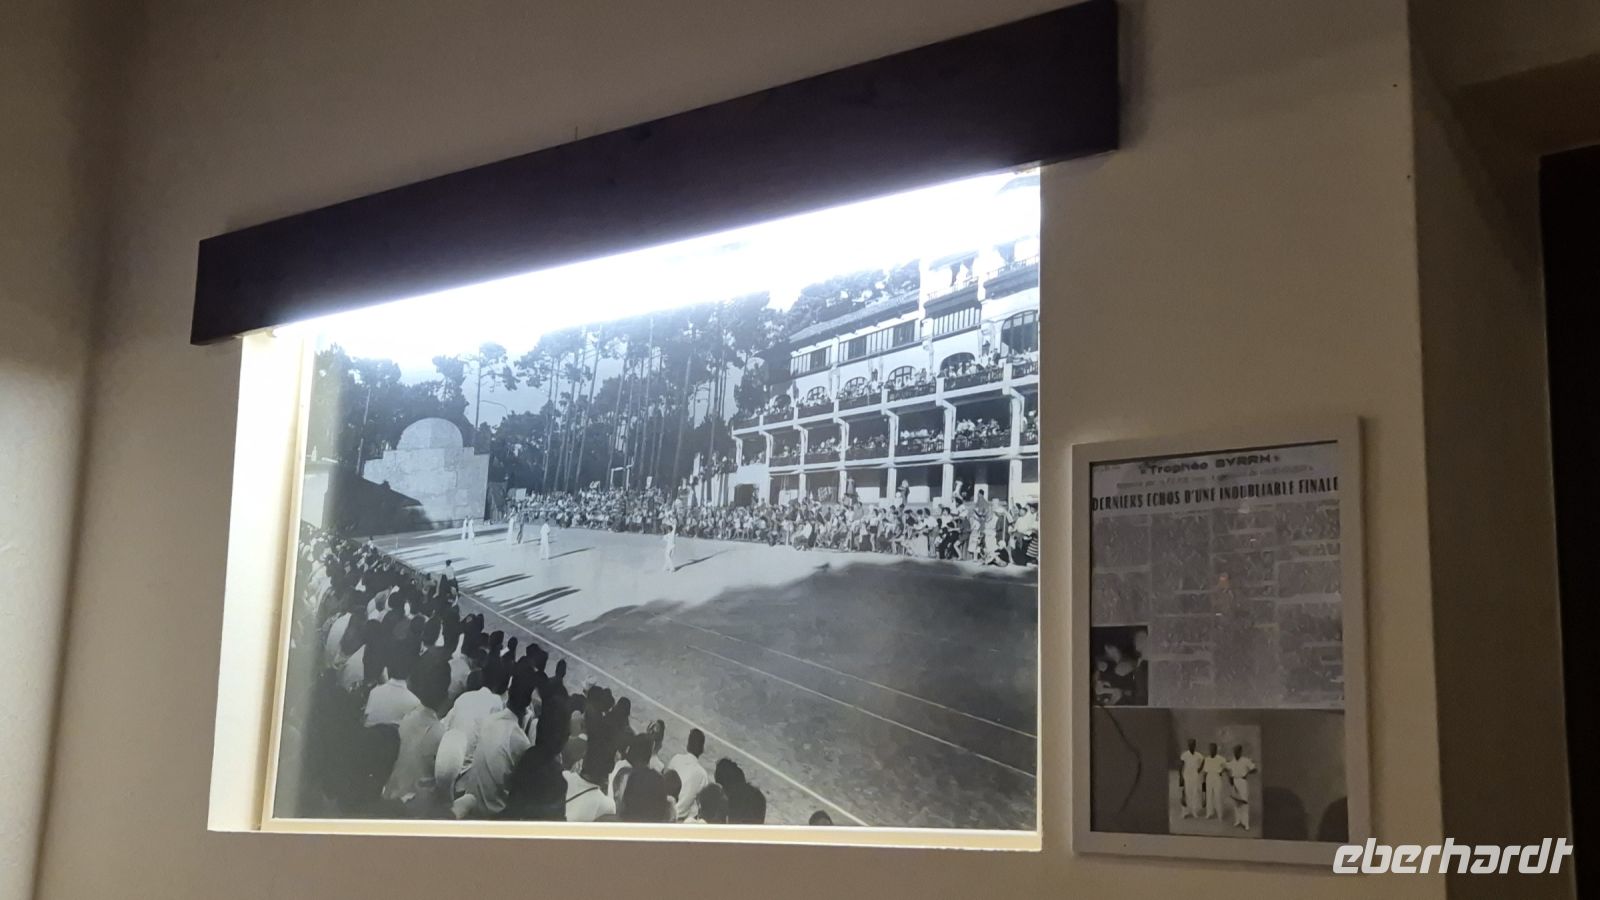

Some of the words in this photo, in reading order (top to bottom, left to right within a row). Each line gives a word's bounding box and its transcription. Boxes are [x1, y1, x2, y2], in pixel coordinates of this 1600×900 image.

[1092, 494, 1143, 511] DERNIERS
[1184, 488, 1215, 504] D'UNE
[1219, 480, 1293, 500] INOUBLIABLE
[1298, 476, 1338, 494] FINALE
